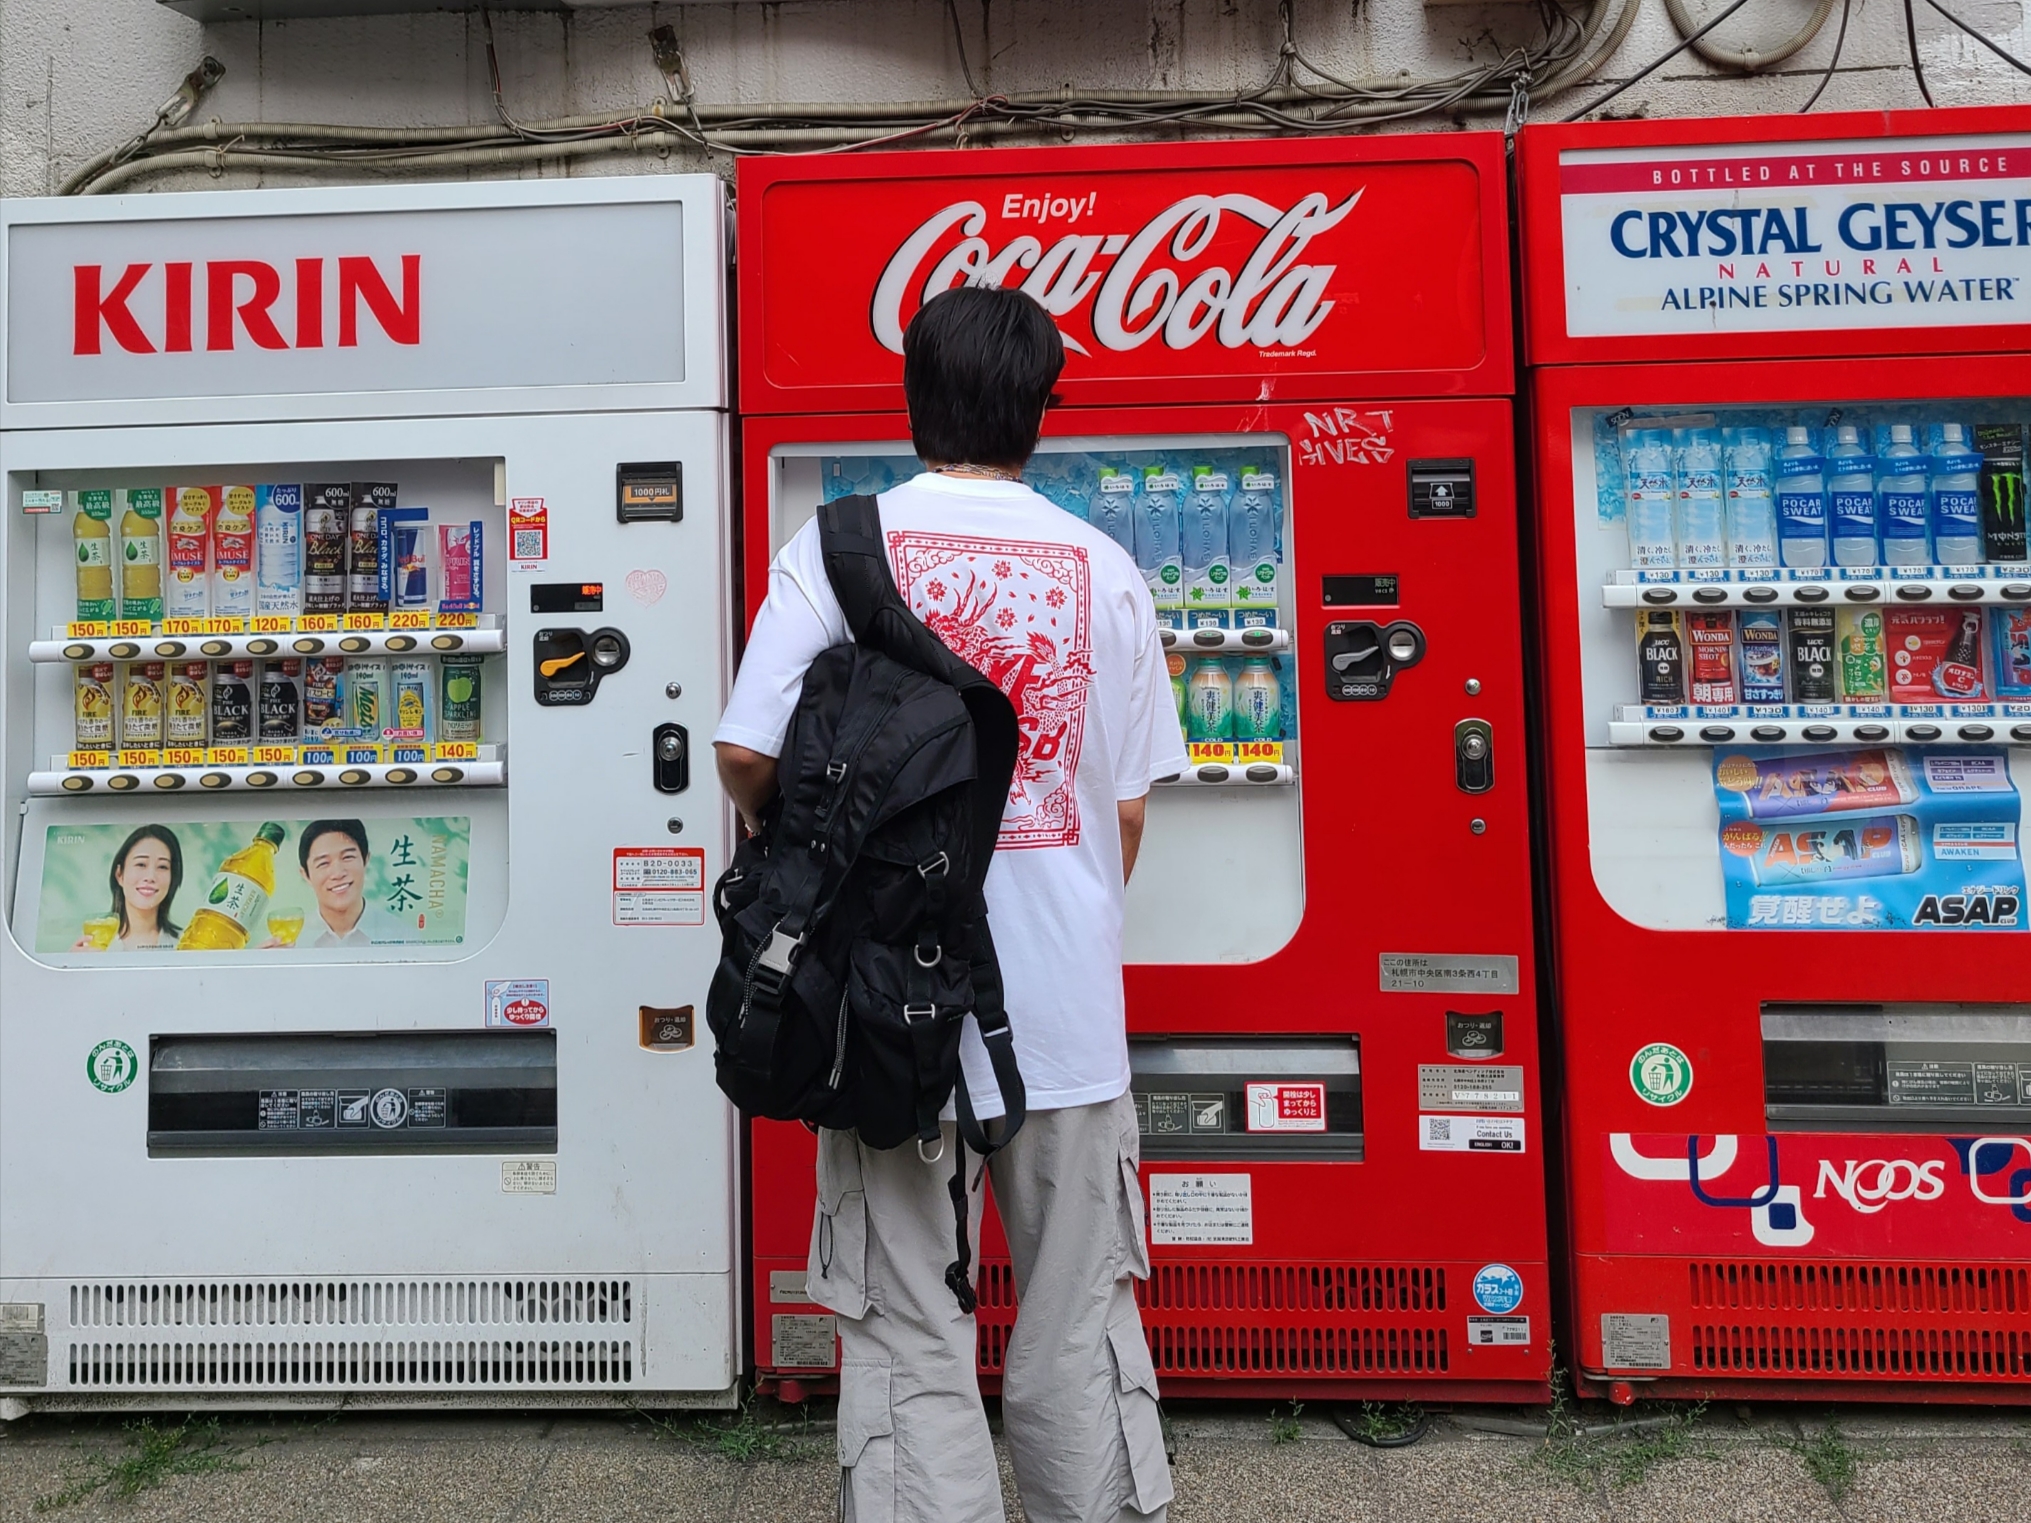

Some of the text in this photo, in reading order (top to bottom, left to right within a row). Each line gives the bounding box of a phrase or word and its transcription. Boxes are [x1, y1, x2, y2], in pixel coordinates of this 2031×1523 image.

[1653, 156, 2008, 184] BOTTLED AT THE SOURCE
[1001, 191, 1097, 224] Enjoy!
[1610, 207, 1822, 259] CRYSTAL
[869, 185, 1367, 358] Coca-Cola
[1718, 257, 1944, 279] NATURAL
[73, 255, 421, 355] KIRIN
[1661, 285, 1768, 311] ALPINE
[1778, 281, 1893, 308] SPRING
[1259, 350, 1296, 358] Trademark
[308, 540, 343, 555] Black
[1646, 647, 1678, 660] BLACK
[1692, 682, 1733, 702] 朝専用
[214, 705, 249, 716] BLACK
[260, 704, 296, 715] BLACK
[57, 836, 85, 844] KIRIN
[1941, 848, 1980, 856] AWAKEN
[387, 835, 423, 912] 生茶
[1751, 895, 1880, 925] 覚醒せよ
[1914, 896, 2017, 924] ASAP
